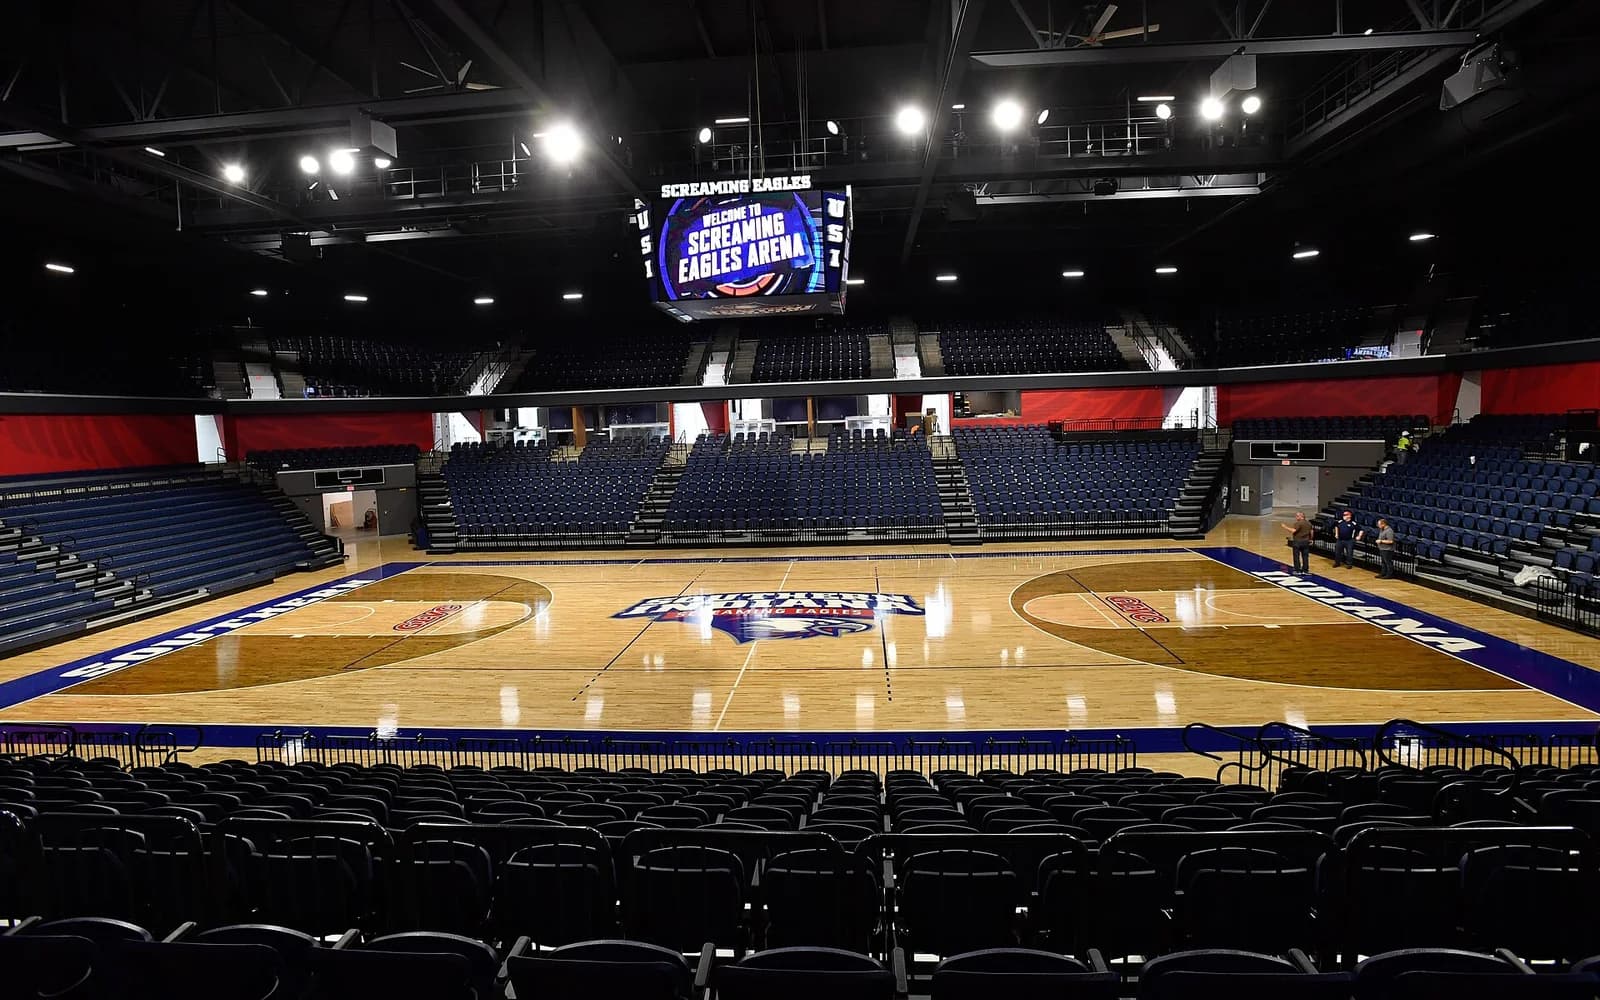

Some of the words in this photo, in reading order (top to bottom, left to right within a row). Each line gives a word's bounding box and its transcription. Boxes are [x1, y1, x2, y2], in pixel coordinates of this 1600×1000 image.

[661, 179, 750, 198] SCREAMING
[752, 175, 812, 193] EAGLES
[702, 206, 748, 228] WELCOME
[749, 203, 762, 217] TO
[827, 197, 846, 268] USI
[687, 212, 785, 256] SCREAMING
[678, 246, 744, 284] EAGLES
[747, 232, 806, 269] ARENA
[621, 598, 923, 615] INDIANA
[639, 592, 908, 606] SOUTHERN
[677, 608, 786, 617] SCEAMING
[795, 608, 863, 616] EAGLES
[1252, 570, 1485, 654] INDIANA
[60, 578, 375, 679] SOUTHERN
